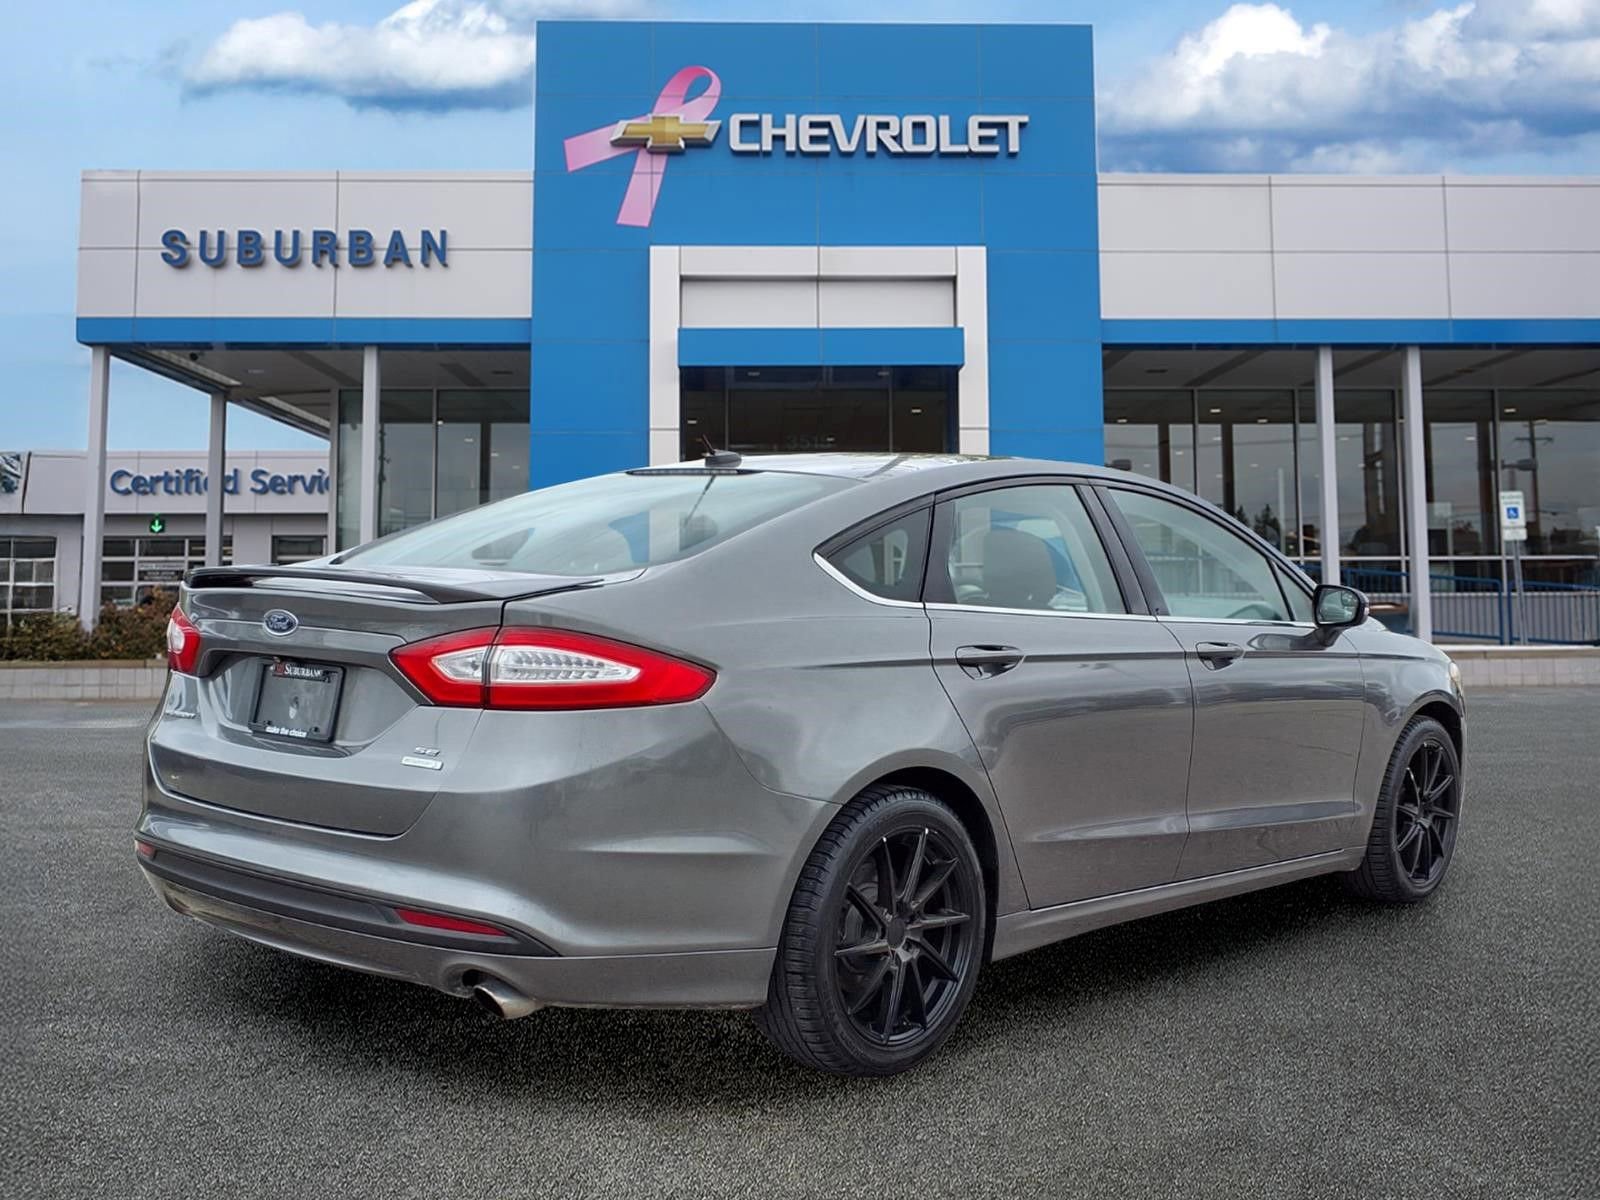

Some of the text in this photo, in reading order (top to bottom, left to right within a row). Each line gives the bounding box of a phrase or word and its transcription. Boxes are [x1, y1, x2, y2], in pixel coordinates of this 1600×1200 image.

[729, 113, 1029, 154] CHEVROLET
[161, 229, 449, 267] SUBURBAN
[110, 468, 329, 495] Certifid Servi
